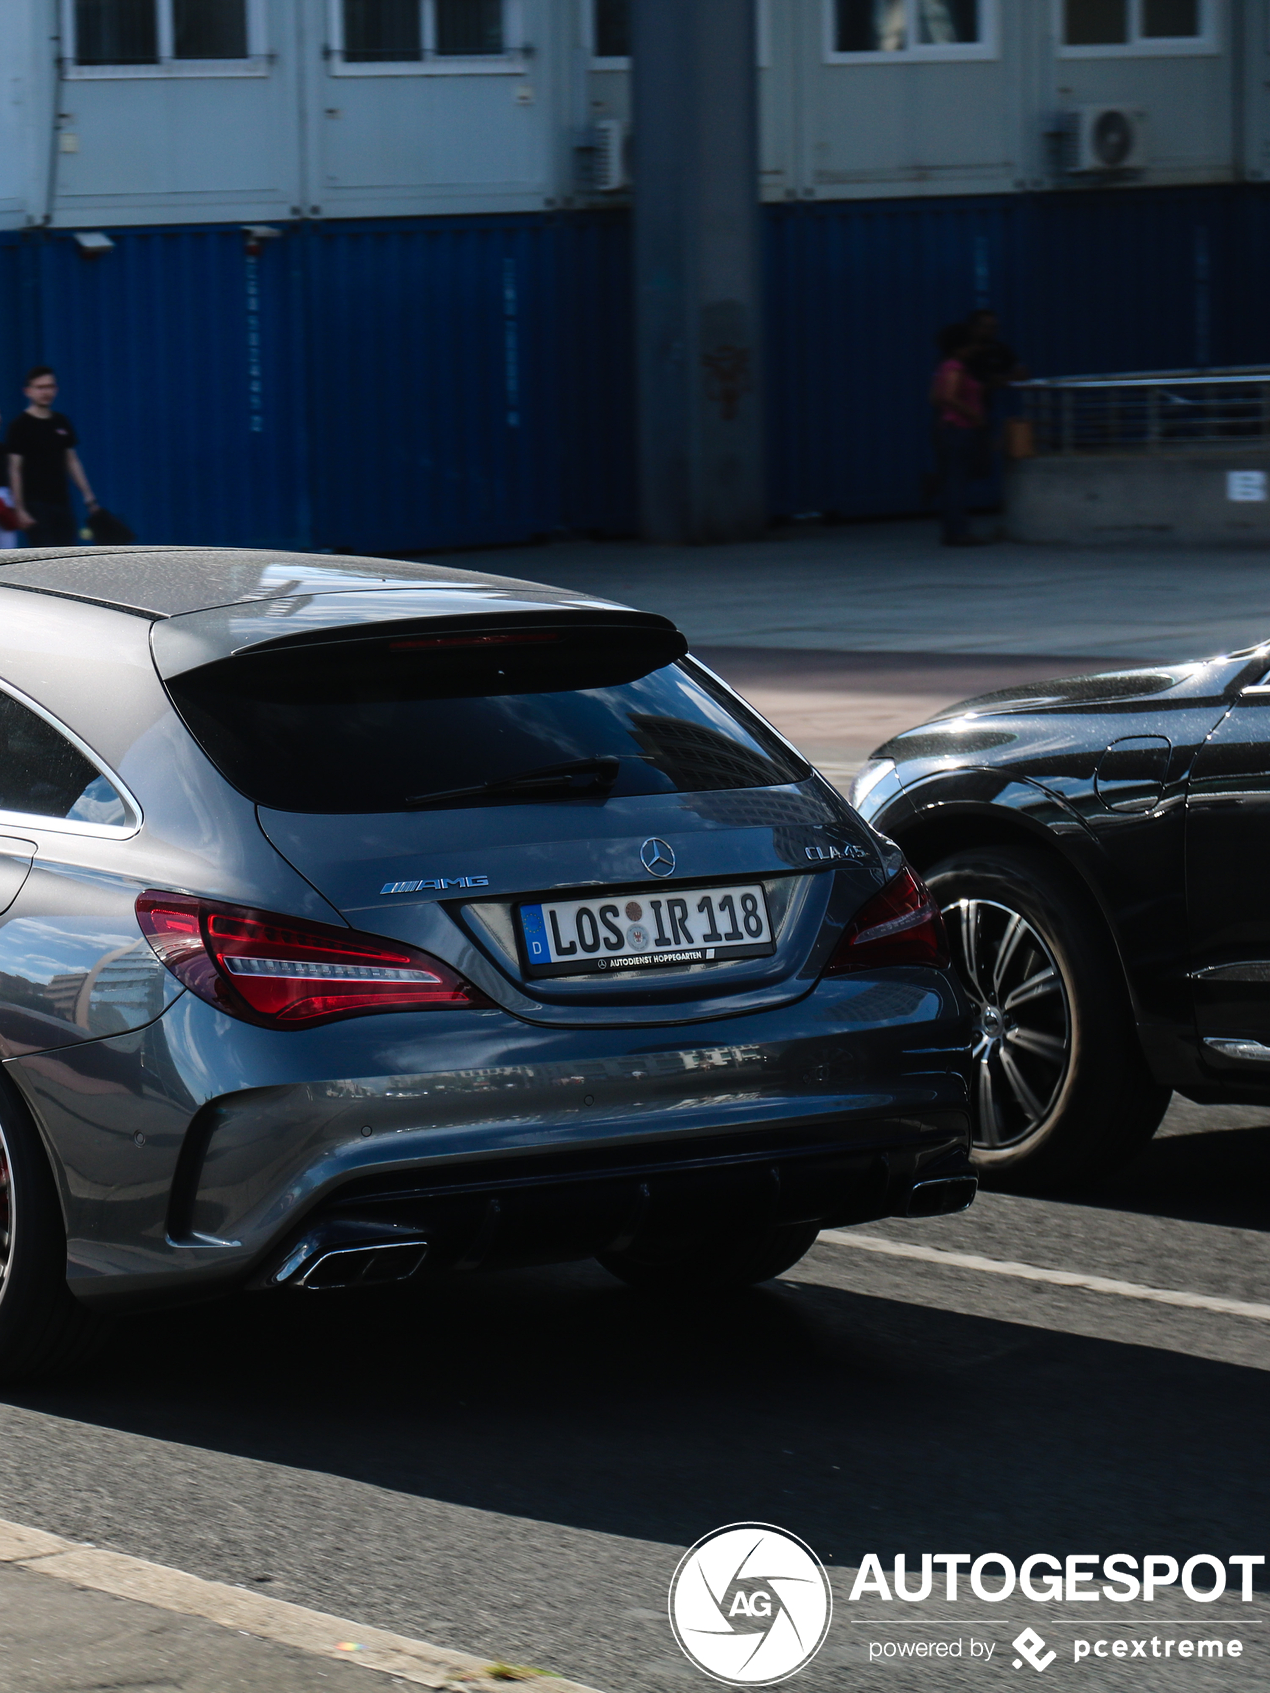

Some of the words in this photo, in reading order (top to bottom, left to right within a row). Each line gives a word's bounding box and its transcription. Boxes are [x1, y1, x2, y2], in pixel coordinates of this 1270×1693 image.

[415, 875, 489, 892] AMG
[549, 904, 625, 956] LOS
[650, 898, 695, 947] IR
[697, 893, 763, 943] 118
[532, 942, 542, 955] D
[609, 955, 653, 968] AUTODIENST
[653, 951, 702, 964] HOPPEGARTEN
